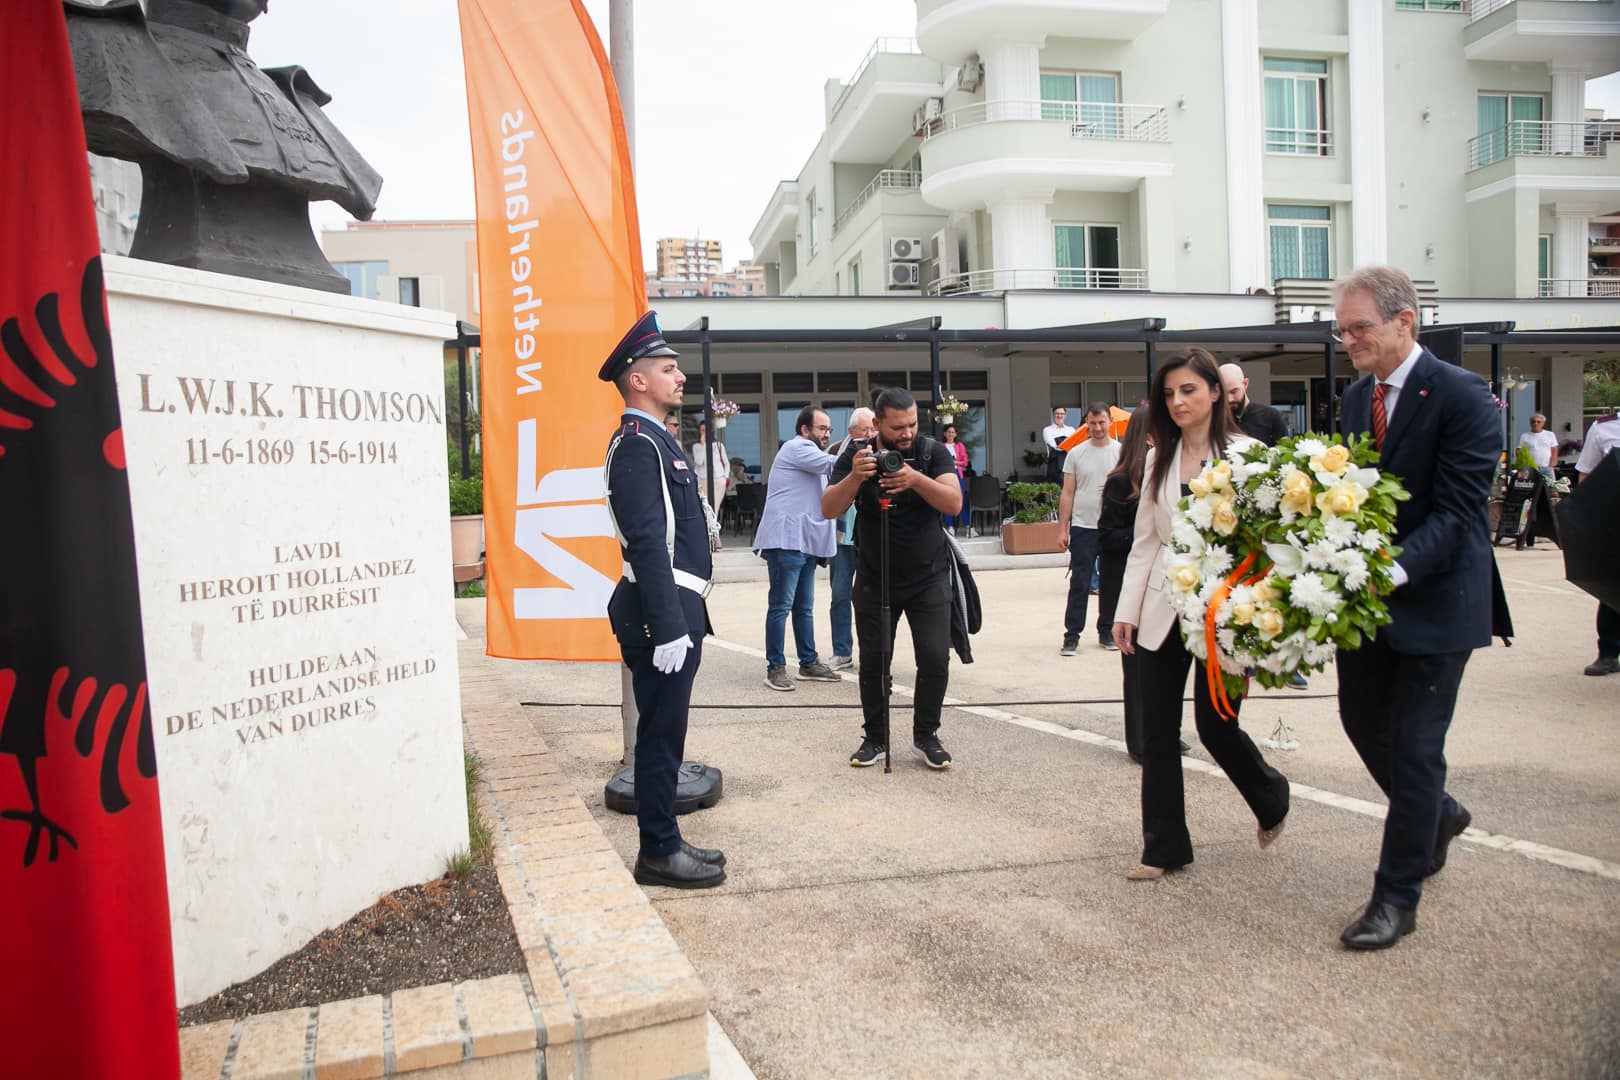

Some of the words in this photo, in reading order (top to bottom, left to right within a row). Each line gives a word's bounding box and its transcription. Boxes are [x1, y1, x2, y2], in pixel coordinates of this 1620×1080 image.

[136, 373, 284, 418] L.W.J.K.
[292, 384, 443, 425] THOMSON
[185, 437, 295, 465] 11-6-1869
[308, 440, 398, 465] 15-6-1914
[274, 541, 341, 564] LAVDI
[179, 573, 281, 603] HEROIT
[287, 558, 416, 589] HOLLANDEZ
[231, 598, 265, 624] TË
[272, 586, 382, 618] DURRËSIT
[249, 655, 330, 688] HULDE
[334, 646, 378, 669] AAN
[166, 710, 204, 736] DE
[211, 670, 381, 723] NEDERLANDSE
[386, 658, 437, 683] HELD
[235, 717, 284, 745] VAN
[291, 695, 377, 733] DURRES
